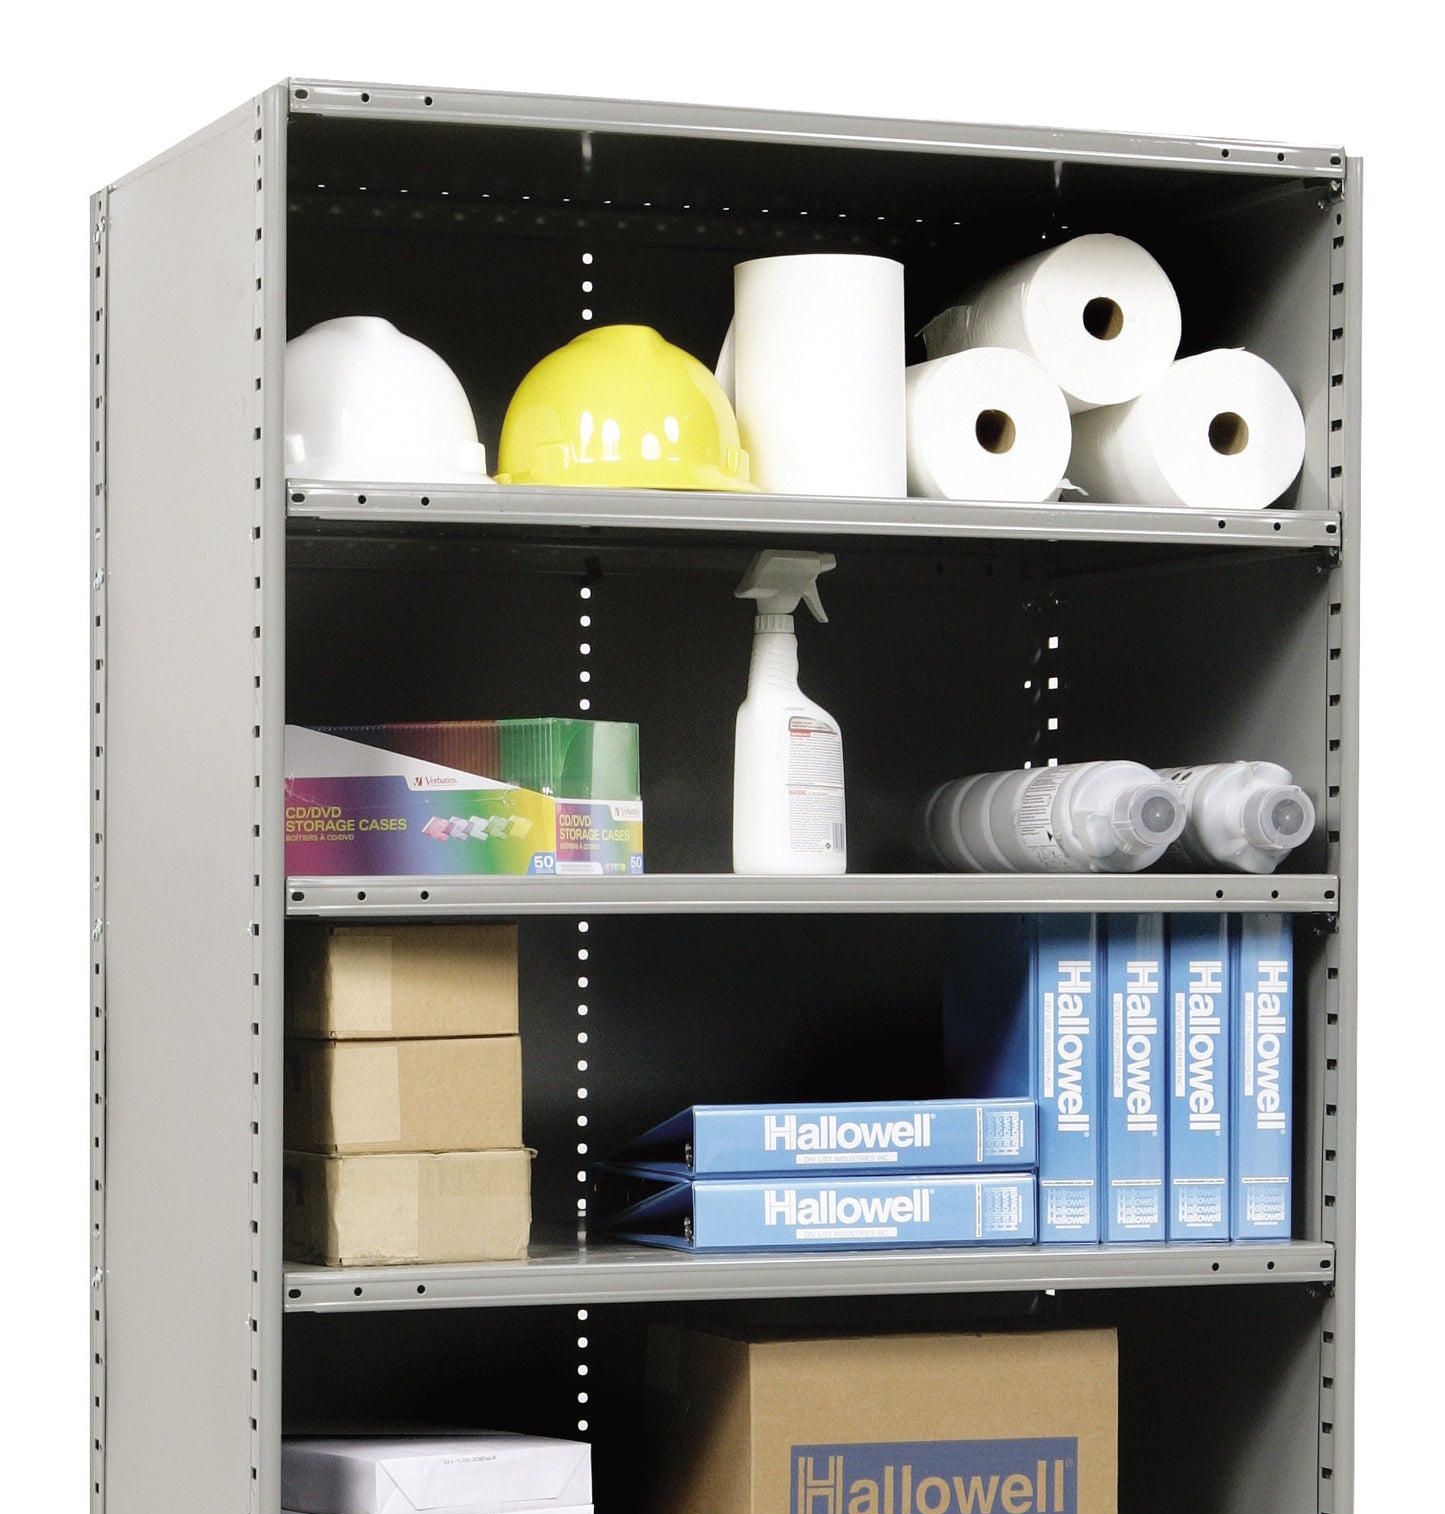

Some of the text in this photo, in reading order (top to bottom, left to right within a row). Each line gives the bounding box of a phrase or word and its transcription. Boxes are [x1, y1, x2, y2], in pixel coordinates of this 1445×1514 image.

[285, 807, 341, 819] CD/DVD
[286, 818, 407, 831] STORAGE CASES
[559, 814, 591, 826] CD/DVD
[560, 828, 630, 841] STORAGE CASES
[534, 855, 554, 868] 50
[630, 856, 642, 869] 50
[1057, 960, 1092, 1132] Hallowell
[1126, 961, 1158, 1132] Hallowell
[1189, 960, 1222, 1131] Hallowell
[1257, 960, 1288, 1130] Hallowell
[764, 1113, 931, 1151] Hallowell
[764, 1188, 930, 1226] Hallowell
